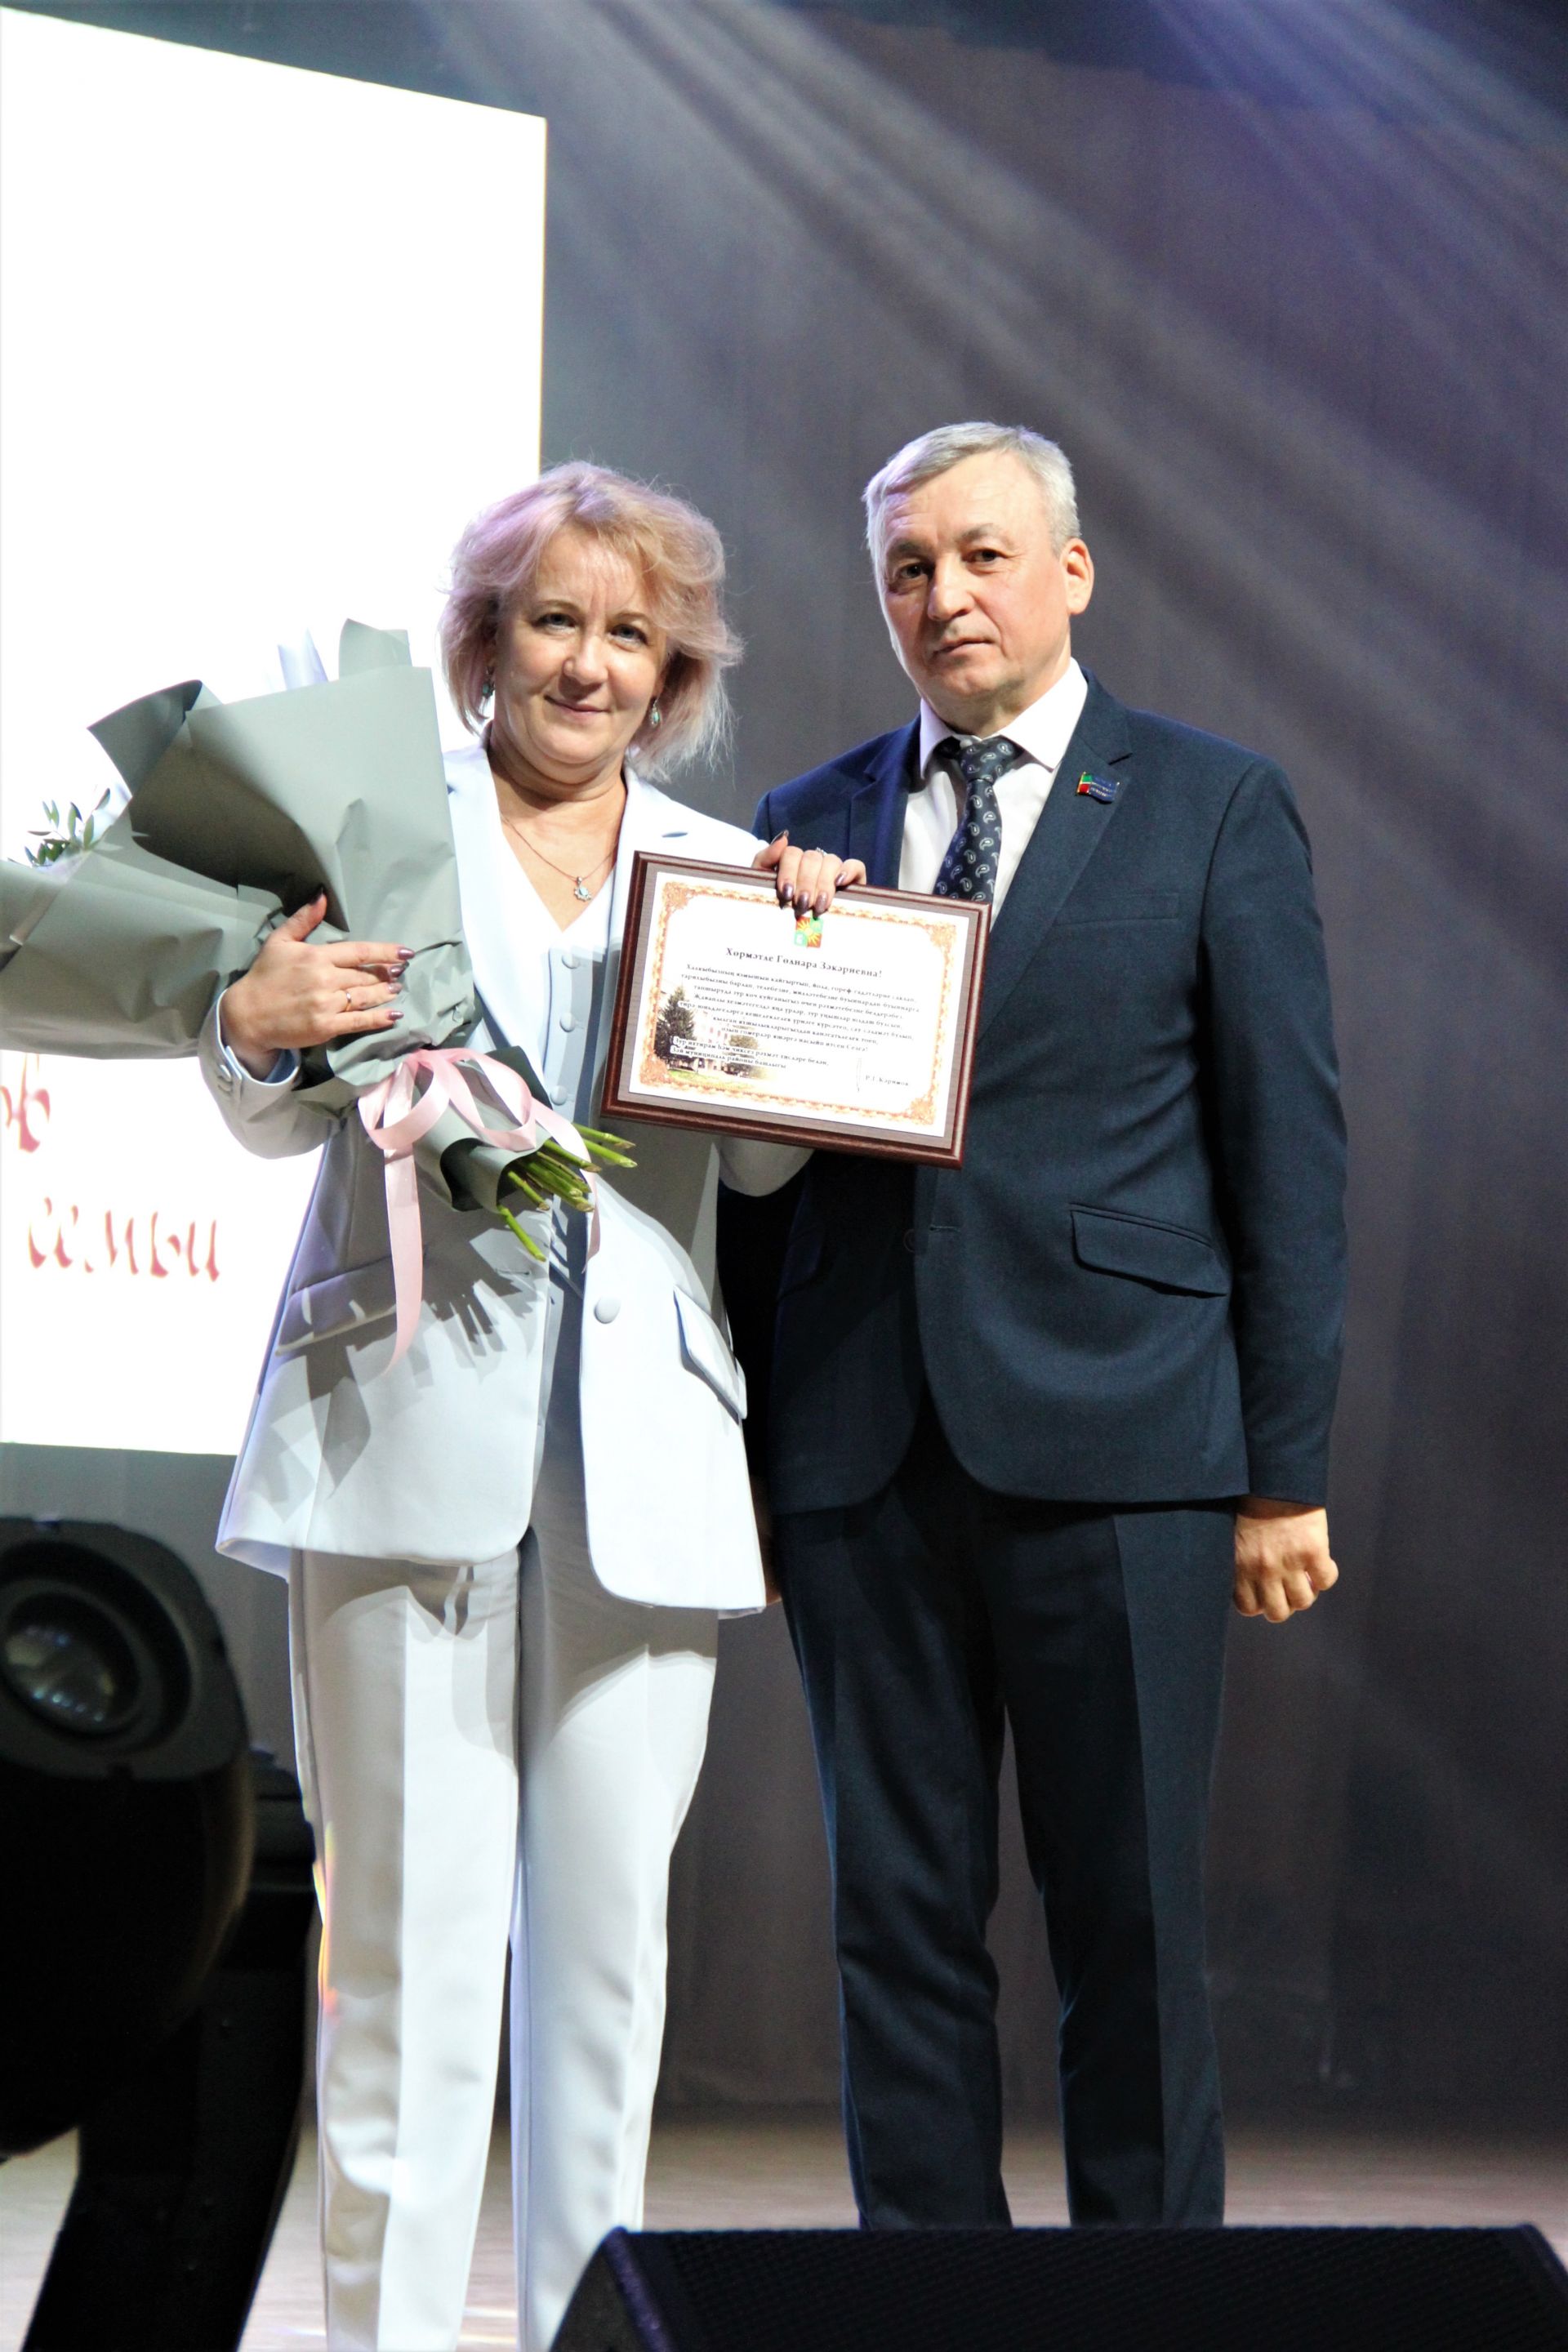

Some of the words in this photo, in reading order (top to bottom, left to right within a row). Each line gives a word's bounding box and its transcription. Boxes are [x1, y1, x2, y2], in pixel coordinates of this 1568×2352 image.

[725, 947, 773, 962] Хөрмәтле
[776, 954, 817, 969] Гөлнара
[822, 961, 882, 977] Зәкәриевна!
